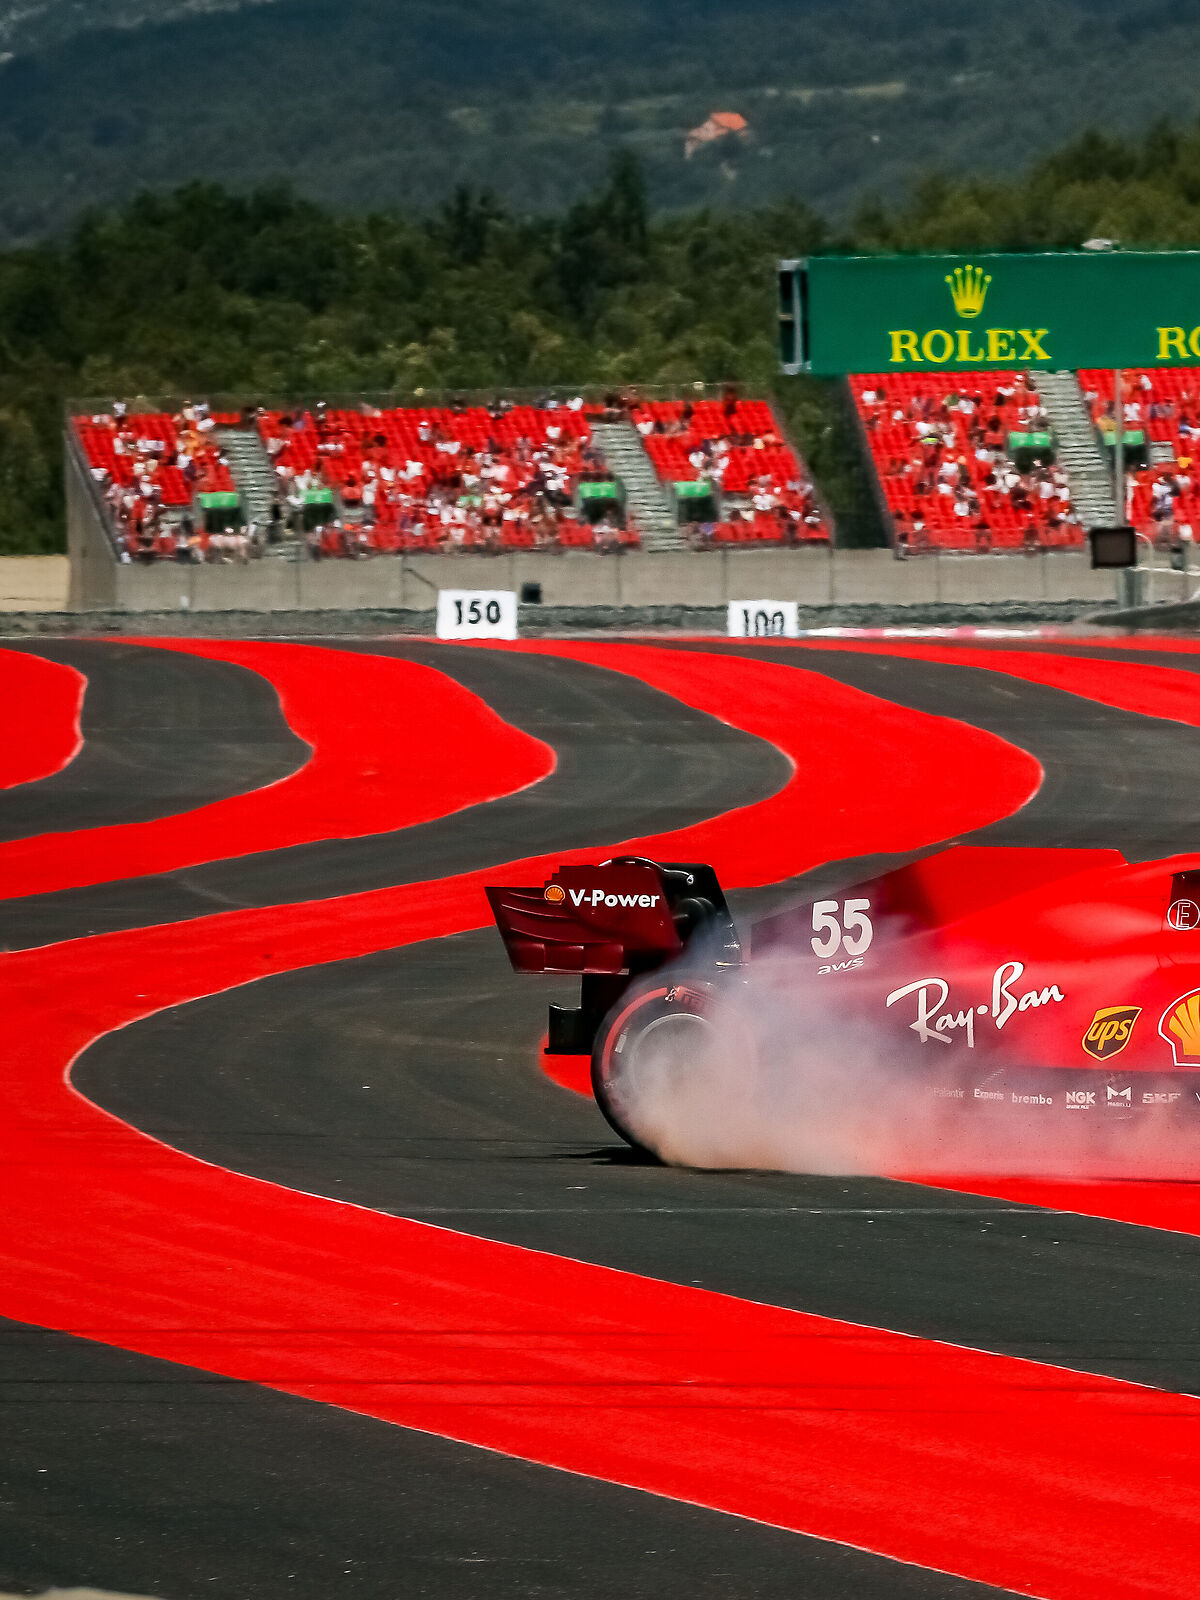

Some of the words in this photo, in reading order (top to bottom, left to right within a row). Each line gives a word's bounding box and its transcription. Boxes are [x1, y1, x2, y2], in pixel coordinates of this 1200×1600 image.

[889, 328, 1051, 363] ROLEX
[455, 599, 501, 625] 150
[568, 888, 660, 908] V-Power
[810, 898, 873, 958] 55
[817, 956, 864, 975] aws
[1087, 1019, 1133, 1051] ups
[1012, 1092, 1053, 1105] brembo
[1065, 1091, 1096, 1104] NGK
